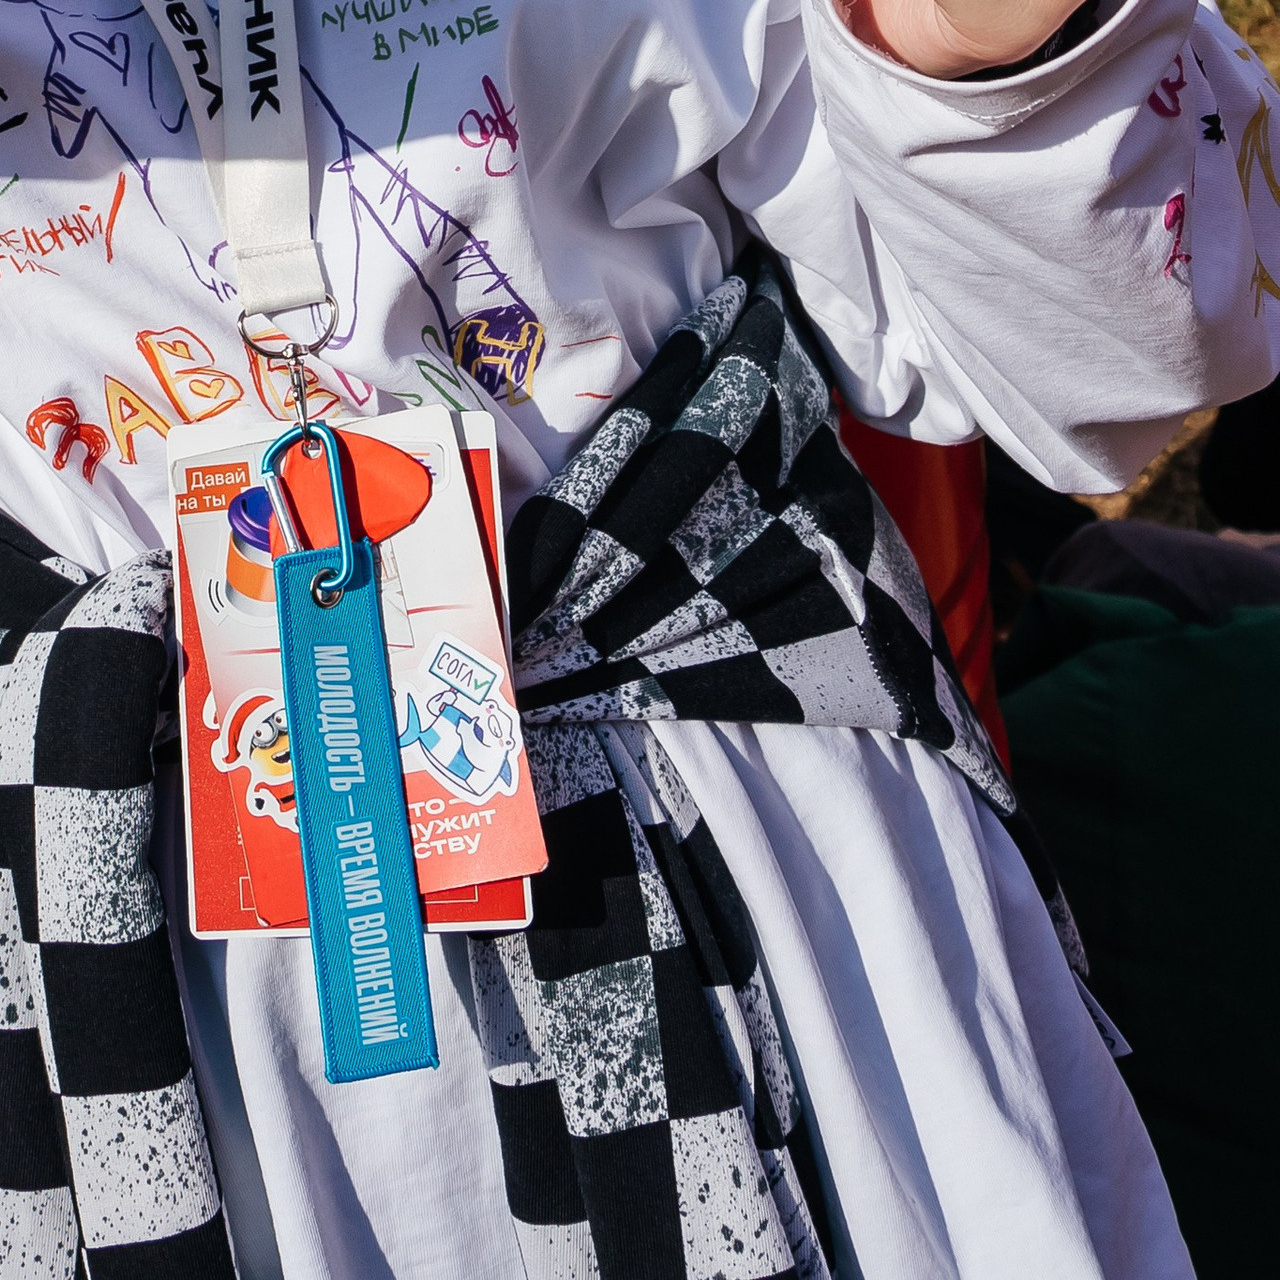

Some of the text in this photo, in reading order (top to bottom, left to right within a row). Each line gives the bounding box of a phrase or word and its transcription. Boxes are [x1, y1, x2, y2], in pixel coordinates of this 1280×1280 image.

[372, 30, 393, 61] В
[177, 493, 227, 512] на ты
[190, 466, 248, 492] Давай
[312, 644, 367, 793] МОЛОДОСТЬ
[335, 819, 384, 910] ВРЕМЯ
[347, 912, 410, 1046] ВОЛНЕНИЙ
